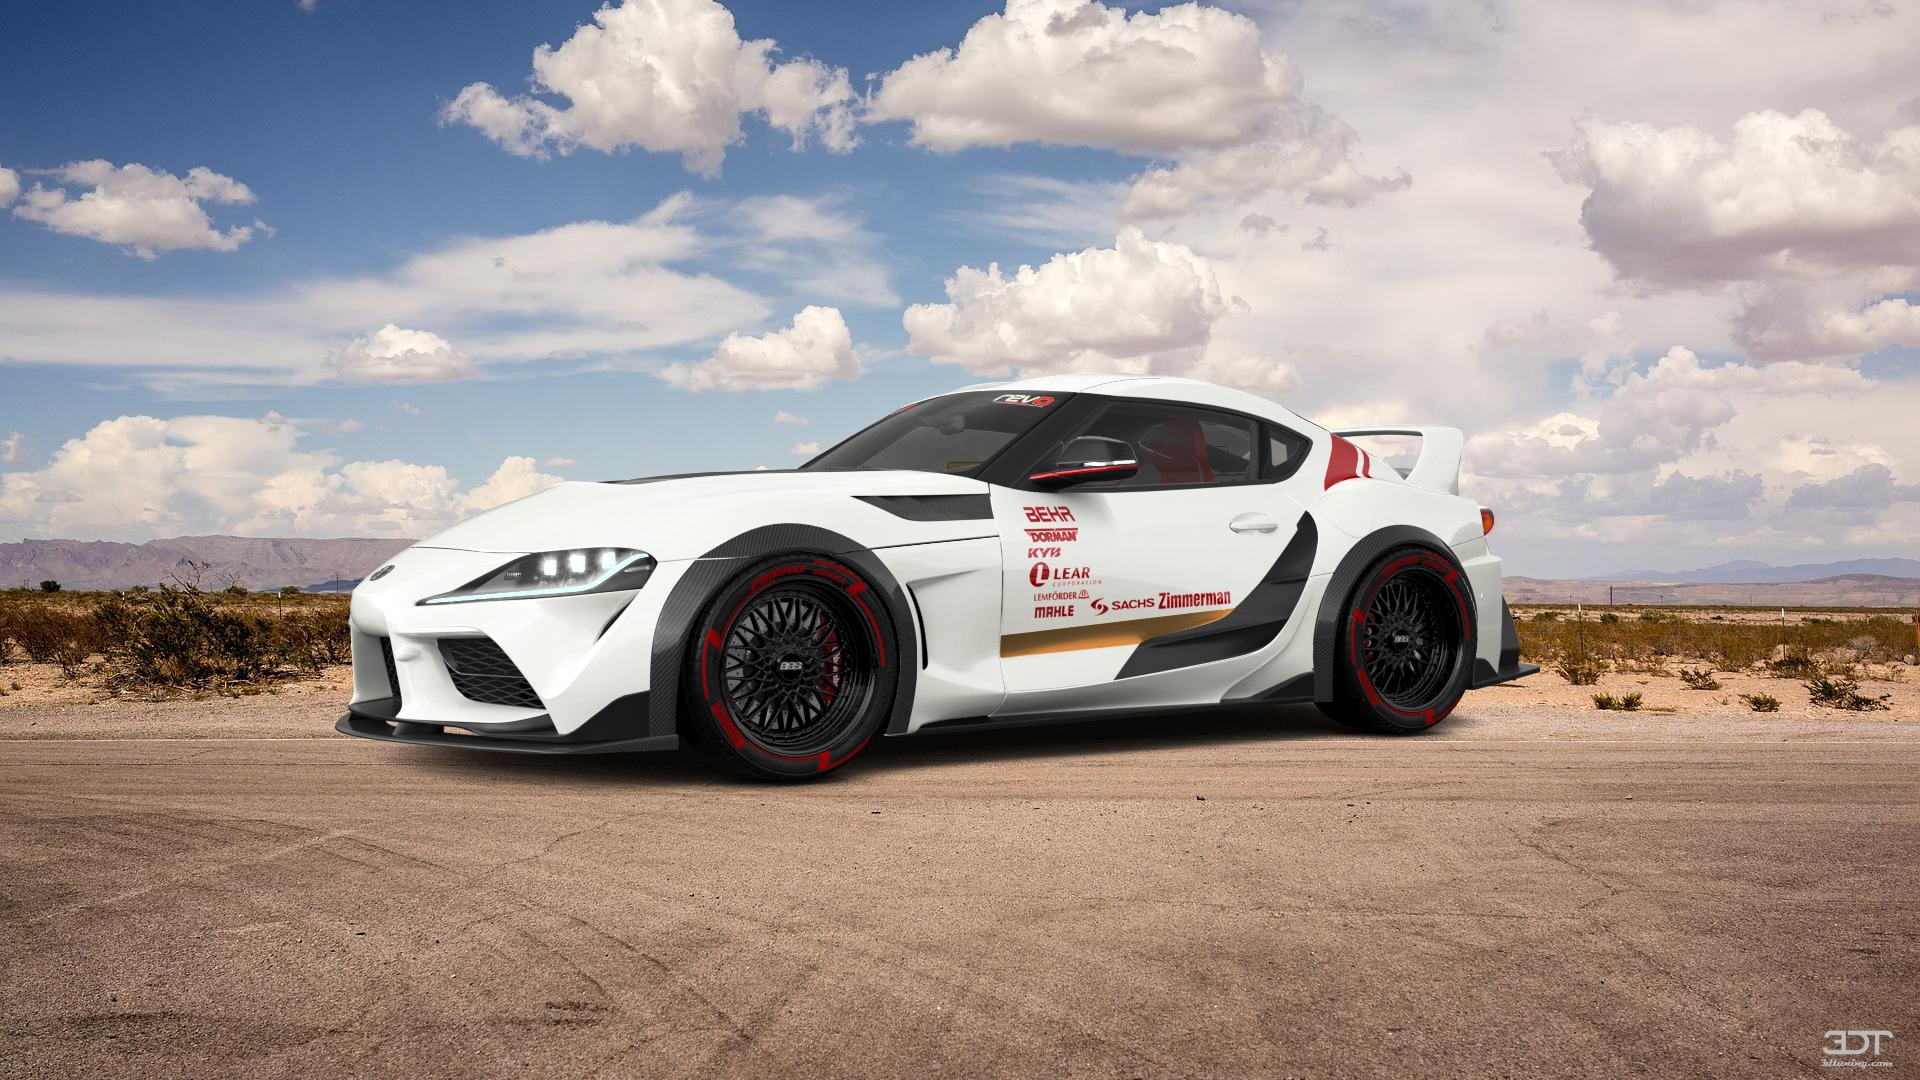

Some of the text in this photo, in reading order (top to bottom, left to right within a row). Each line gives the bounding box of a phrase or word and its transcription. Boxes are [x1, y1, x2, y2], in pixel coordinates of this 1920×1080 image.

[1023, 506, 1076, 522] BEHR
[1029, 531, 1077, 542] DORMAN
[1028, 547, 1061, 558] KYB
[1053, 567, 1091, 580] LEAR
[1033, 591, 1077, 602] LEMFÖRDER
[1158, 591, 1231, 609] Zimmerman
[1111, 598, 1156, 610] SACHS
[1034, 605, 1075, 618] MAHLE
